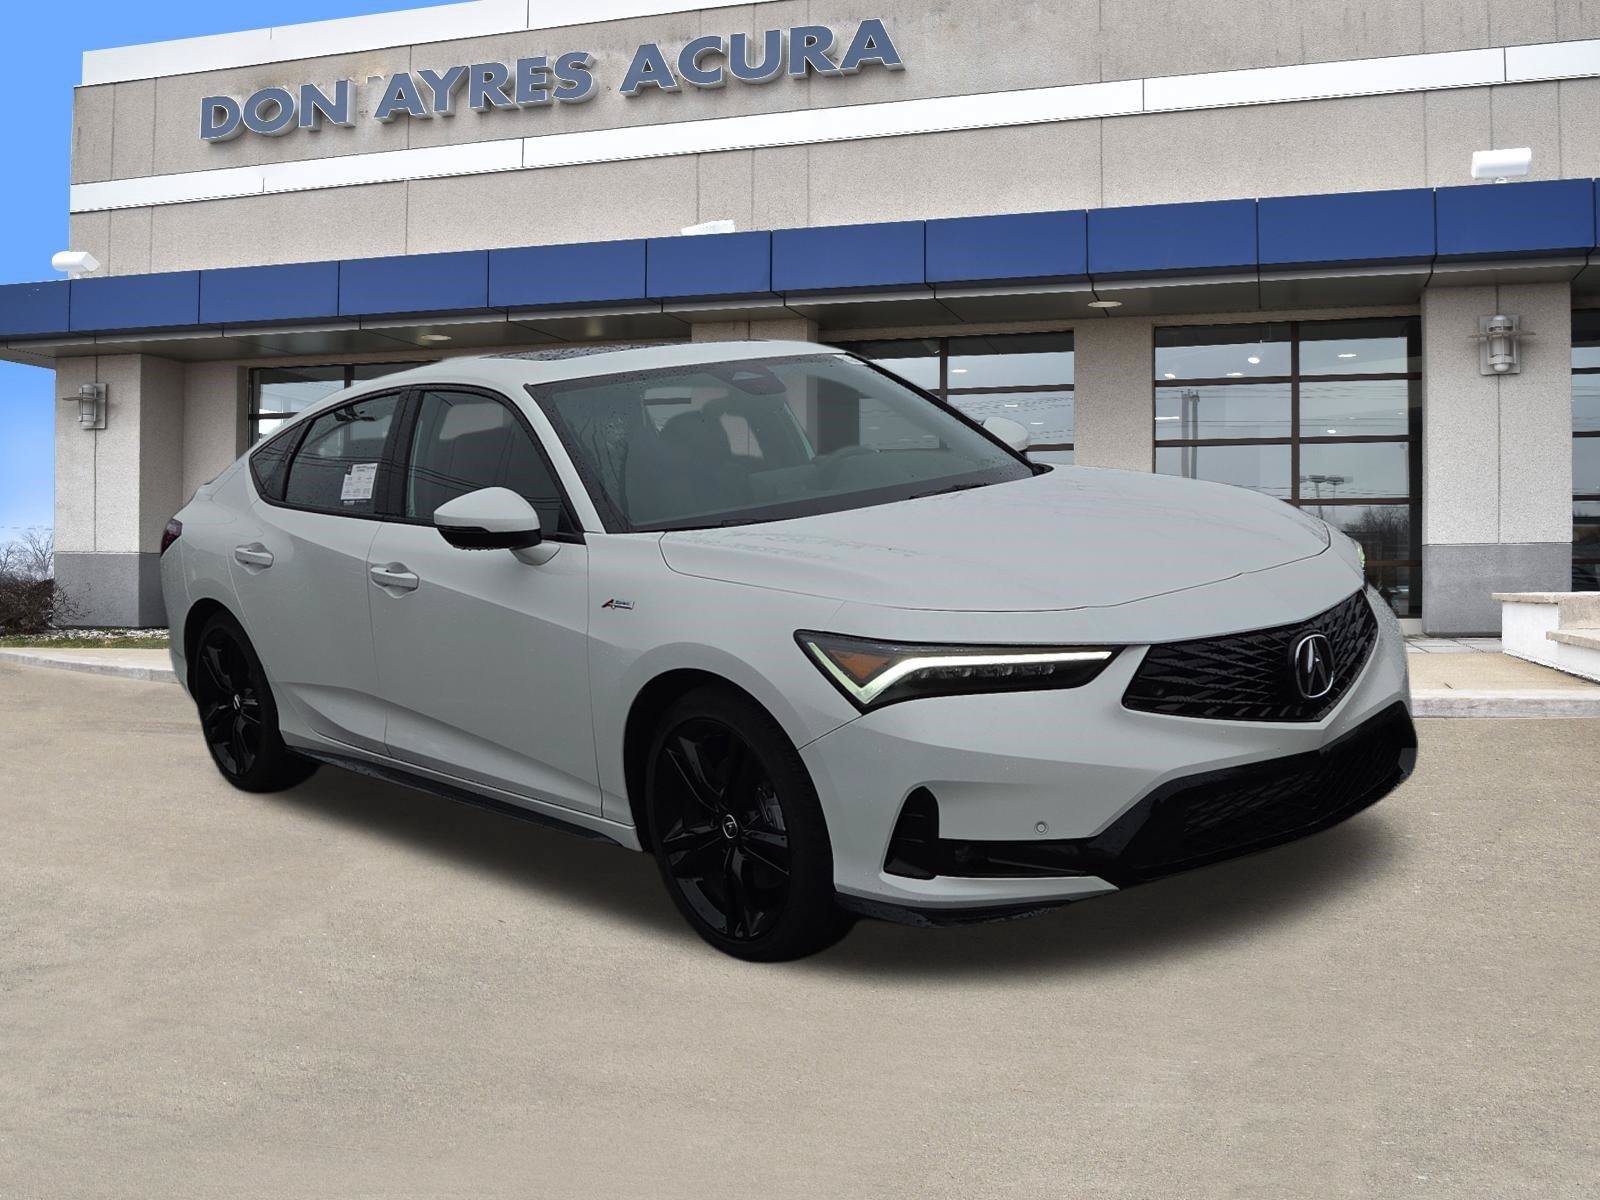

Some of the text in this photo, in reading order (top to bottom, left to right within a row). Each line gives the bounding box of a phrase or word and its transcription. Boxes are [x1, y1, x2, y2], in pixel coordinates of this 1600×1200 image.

[200, 18, 904, 142] DON AYRES ACURA
